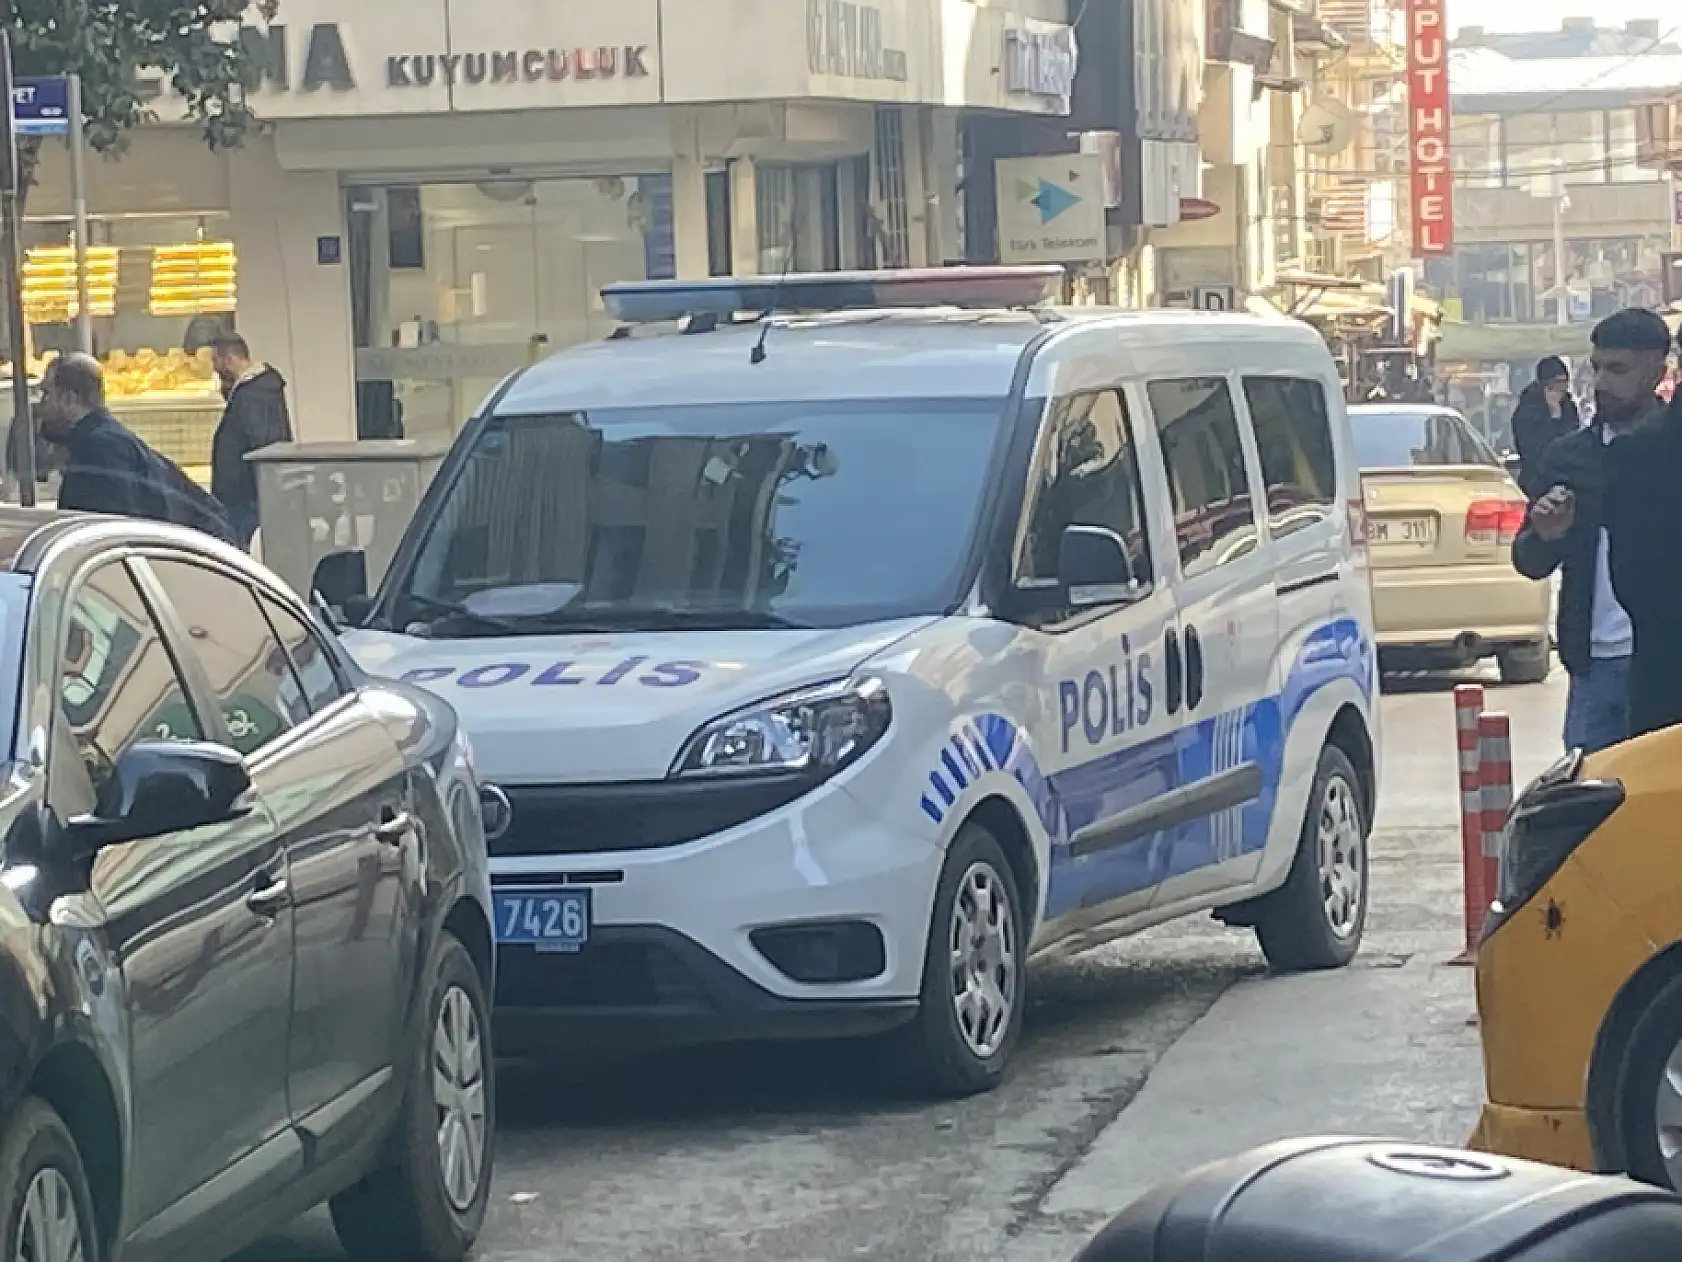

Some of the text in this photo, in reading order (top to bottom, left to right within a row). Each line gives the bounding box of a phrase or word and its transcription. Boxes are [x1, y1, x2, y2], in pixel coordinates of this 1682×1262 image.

[386, 45, 650, 87] KUYUMCULUK
[1414, 0, 1445, 250] PUT HOTEL
[1059, 632, 1153, 754] POLİS
[504, 898, 581, 937] 7426
